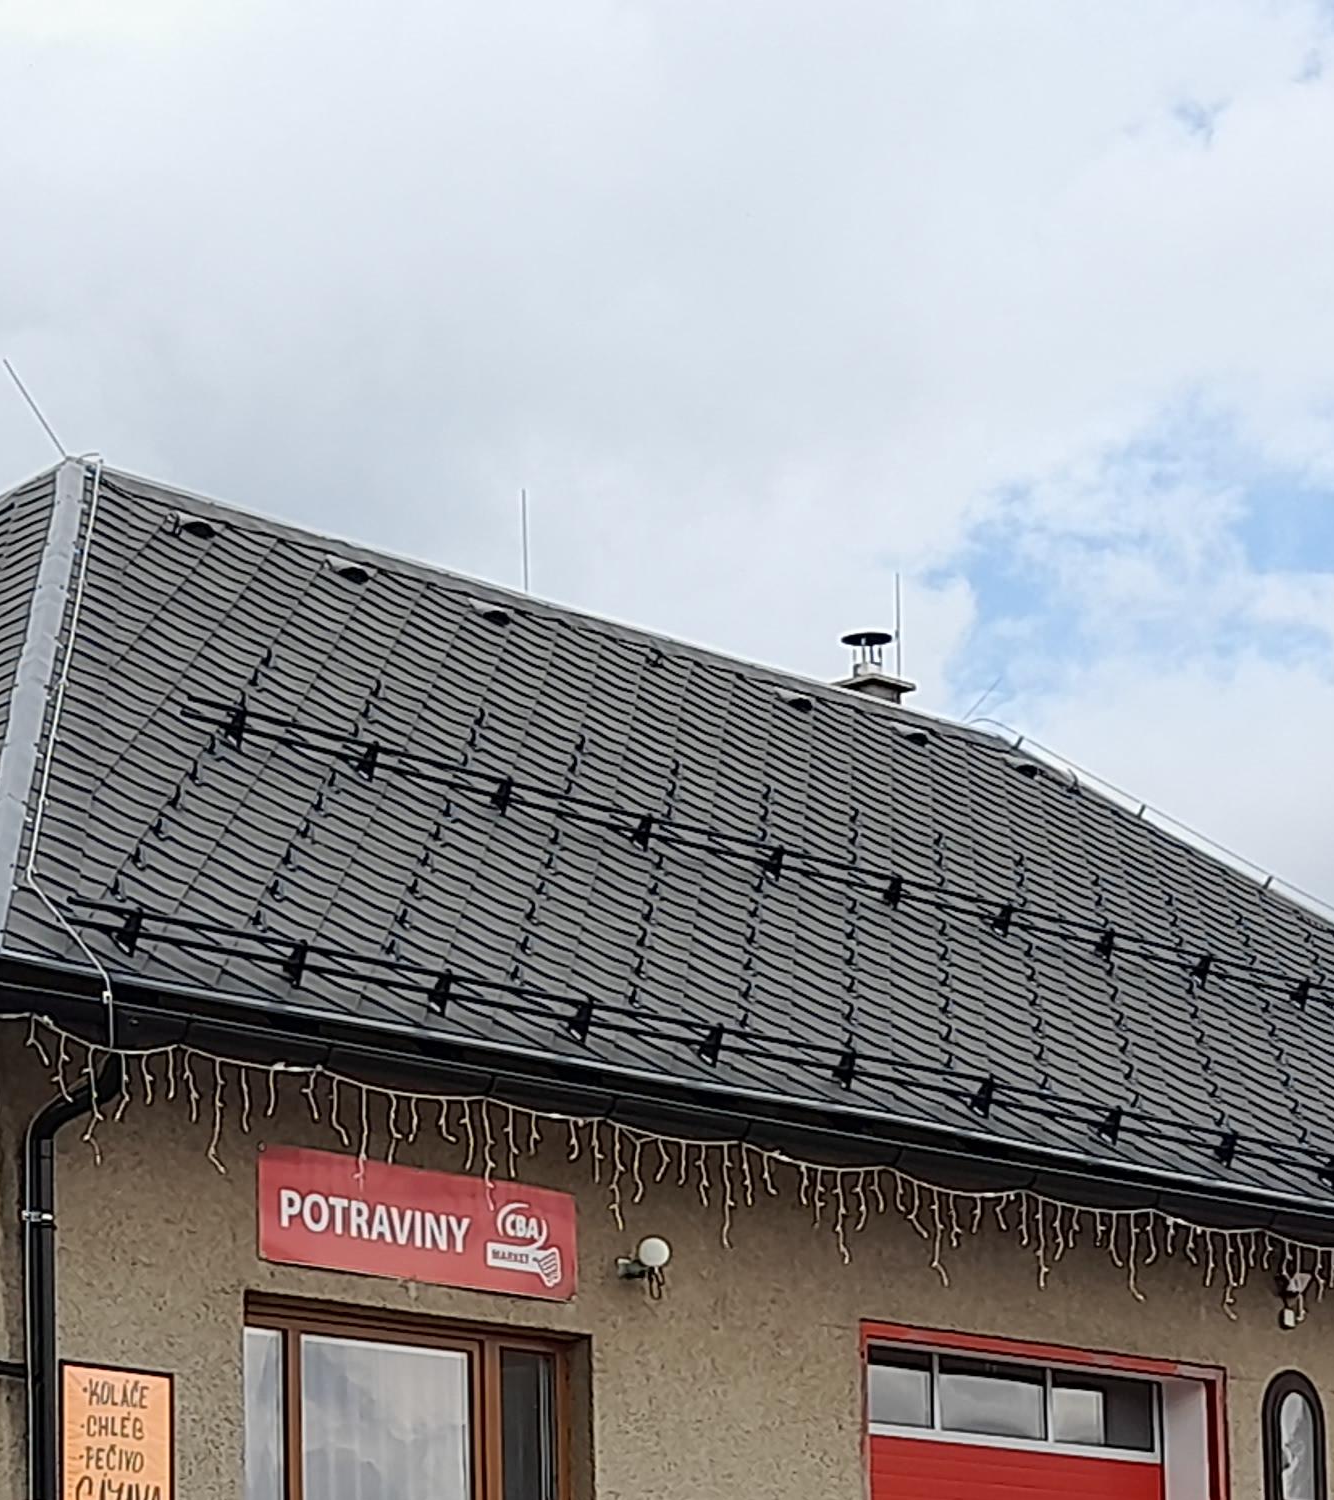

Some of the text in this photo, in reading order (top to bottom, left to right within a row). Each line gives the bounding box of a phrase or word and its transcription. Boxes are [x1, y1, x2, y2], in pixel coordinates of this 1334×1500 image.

[279, 1187, 471, 1253] POTRAVINY
[505, 1212, 541, 1241] CBA
[491, 1249, 530, 1265] MARKET
[88, 1378, 150, 1409] KOLÁČE
[86, 1411, 145, 1440] CHLÉB
[85, 1444, 145, 1473] PEČIVO
